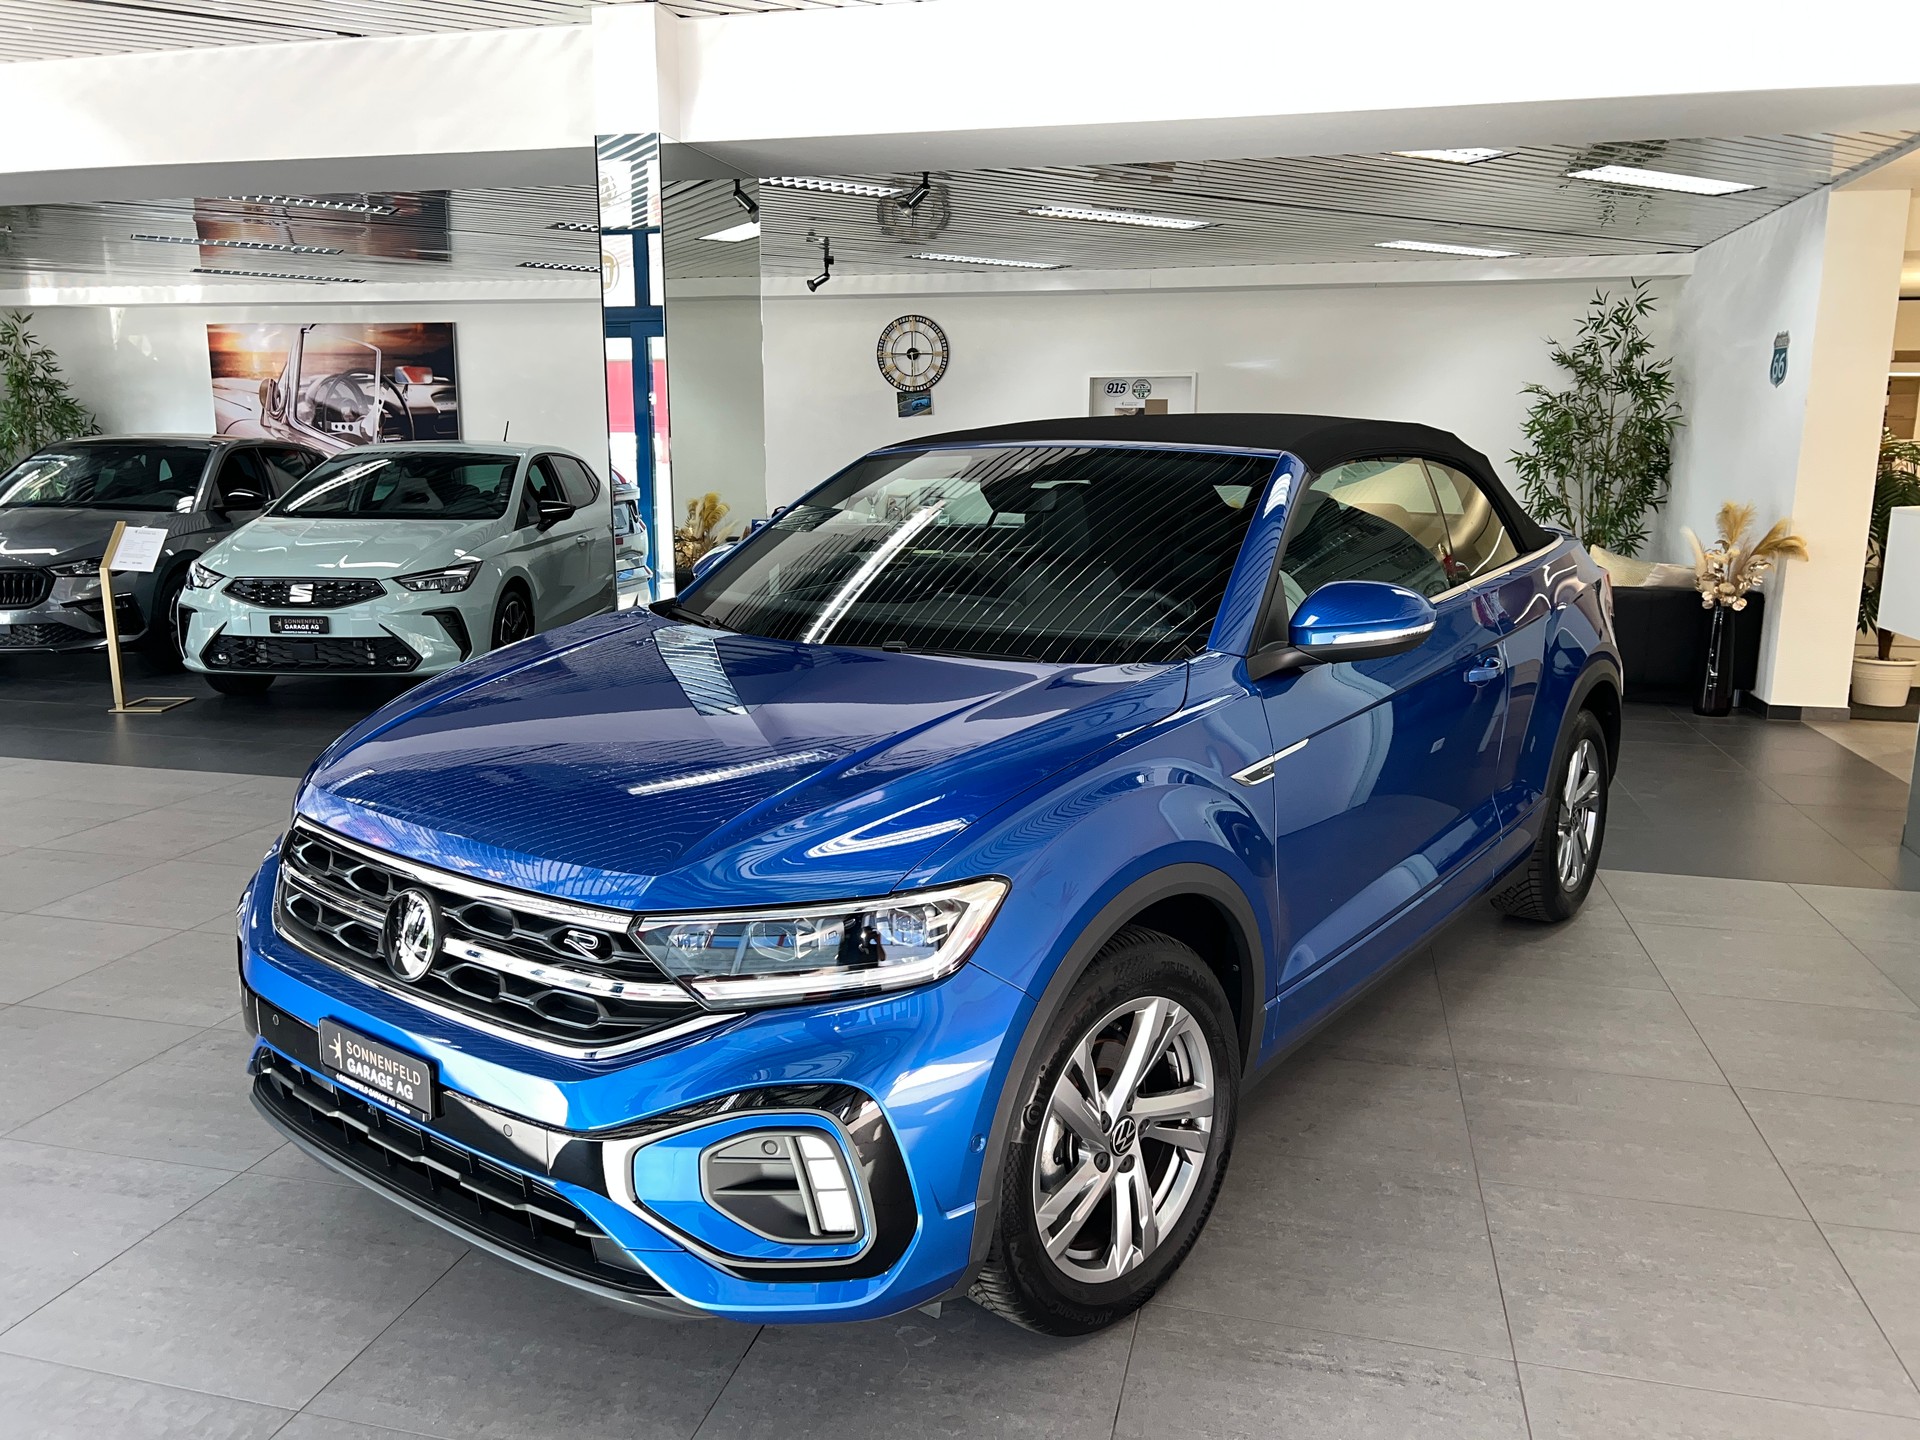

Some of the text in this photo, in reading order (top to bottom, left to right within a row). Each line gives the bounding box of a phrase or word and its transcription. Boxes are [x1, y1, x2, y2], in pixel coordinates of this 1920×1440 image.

[1772, 352, 1786, 379] 66
[1106, 382, 1127, 394] 915
[563, 930, 599, 960] R
[346, 1040, 421, 1086] SONNENFELD
[347, 1058, 414, 1101] GARAGE AG
